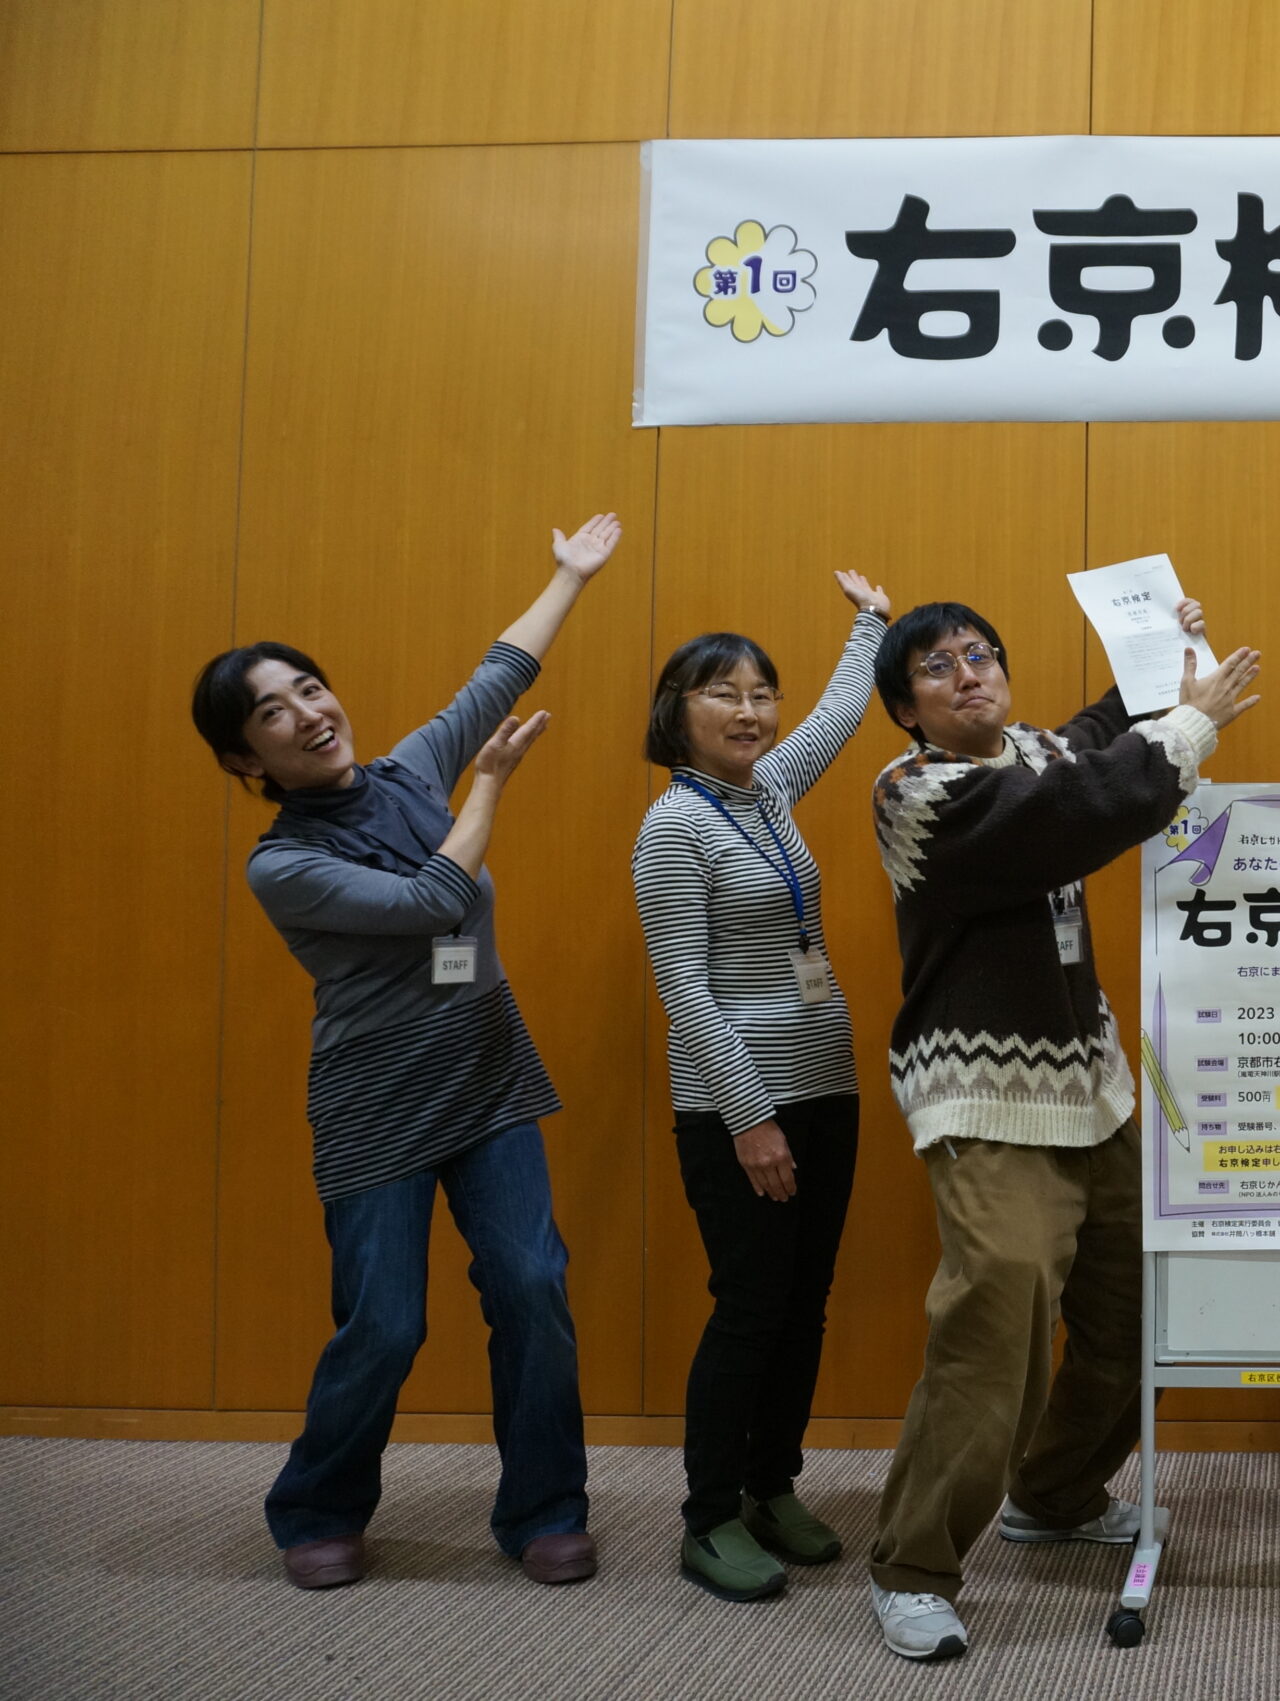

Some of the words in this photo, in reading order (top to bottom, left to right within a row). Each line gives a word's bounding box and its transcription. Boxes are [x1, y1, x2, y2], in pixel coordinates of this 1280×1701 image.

[712, 255, 798, 296] 第1回
[1169, 819, 1202, 835] 第1回
[442, 960, 468, 970] STAFF
[1237, 1007, 1275, 1020] 2023
